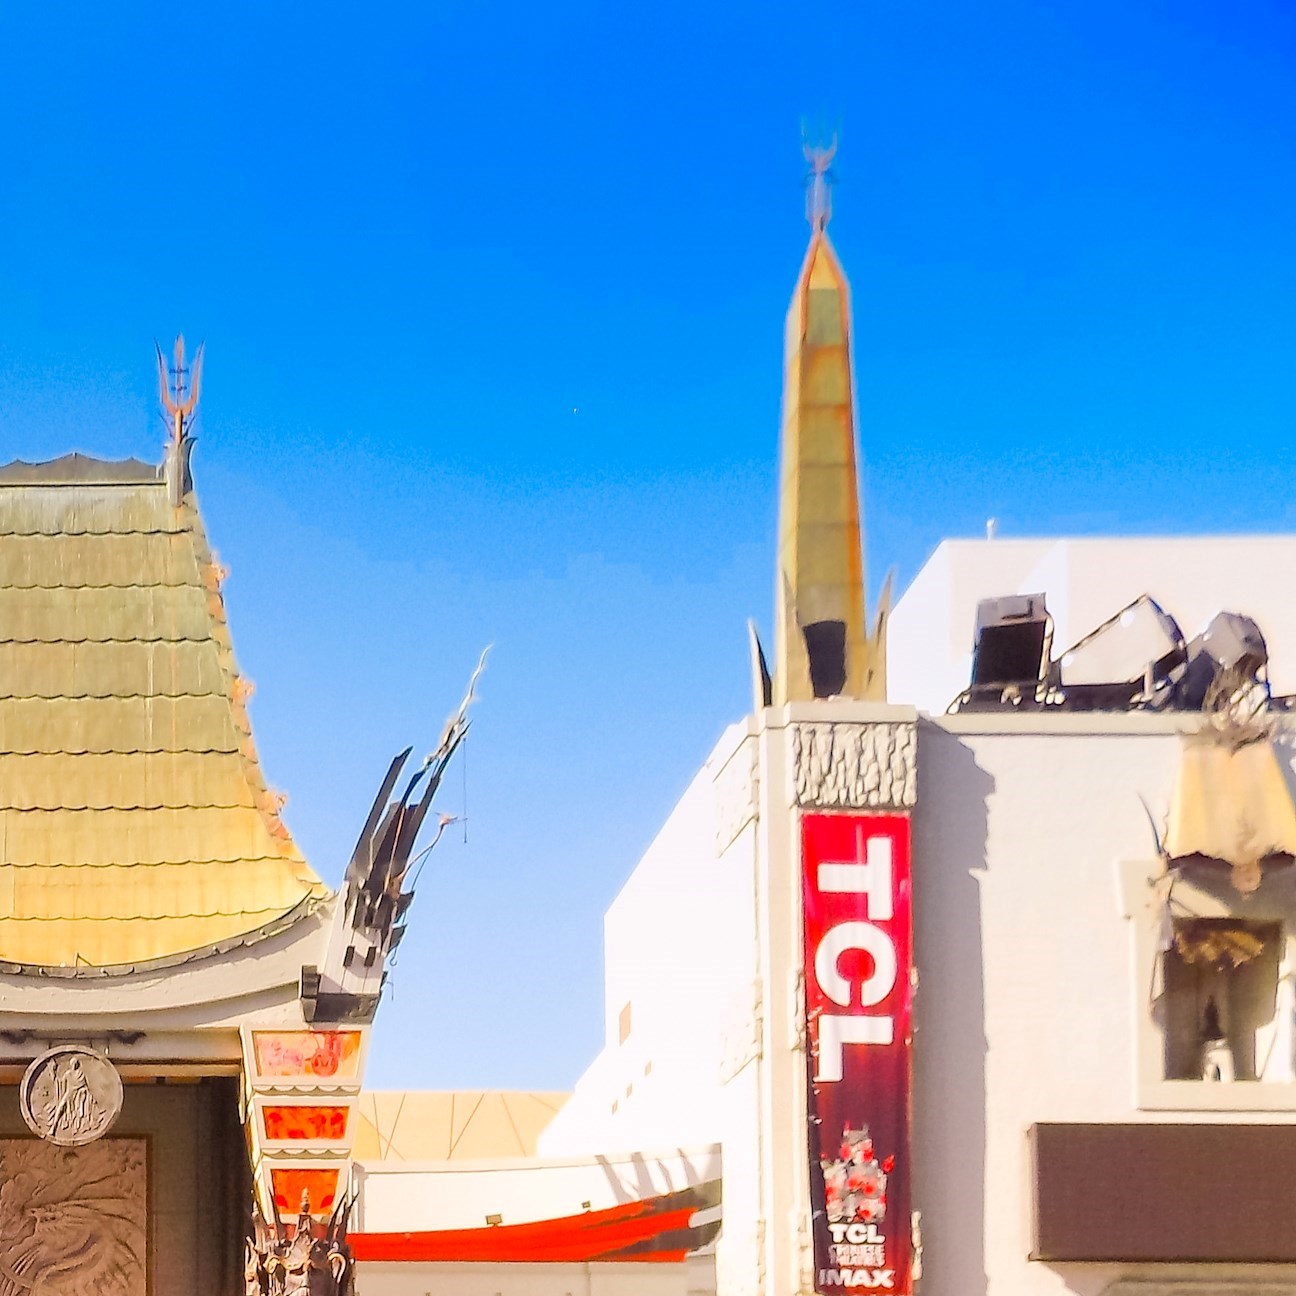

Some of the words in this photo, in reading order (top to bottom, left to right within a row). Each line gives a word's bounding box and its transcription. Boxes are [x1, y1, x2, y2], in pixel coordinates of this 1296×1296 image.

[814, 837, 897, 1082] TCL
[827, 1223, 885, 1244] TCL
[818, 1269, 896, 1288] IMAX
